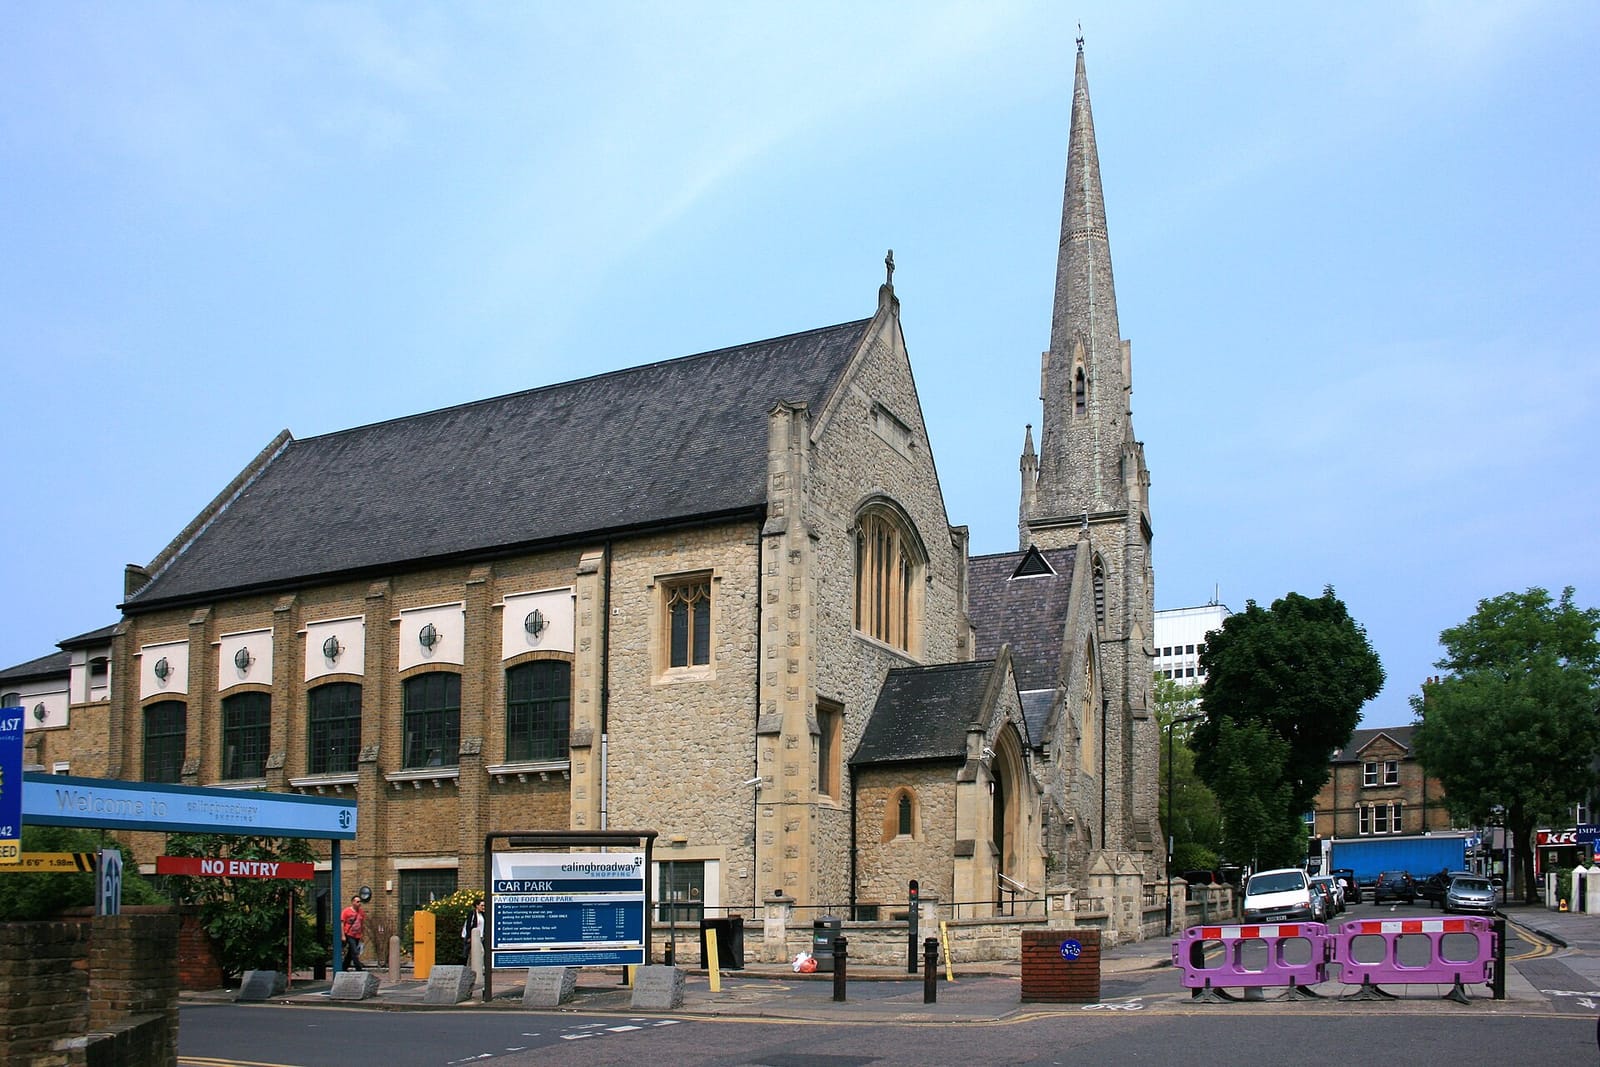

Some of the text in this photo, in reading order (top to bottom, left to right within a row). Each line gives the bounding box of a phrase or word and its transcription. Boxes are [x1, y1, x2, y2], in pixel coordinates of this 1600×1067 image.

[56, 789, 168, 817] Welcome to
[0, 826, 12, 837] 42
[1547, 832, 1577, 843] KFC
[201, 859, 279, 876] NO ENTRY
[561, 862, 636, 874] ealingbroadway
[498, 880, 553, 891] CAR PARK
